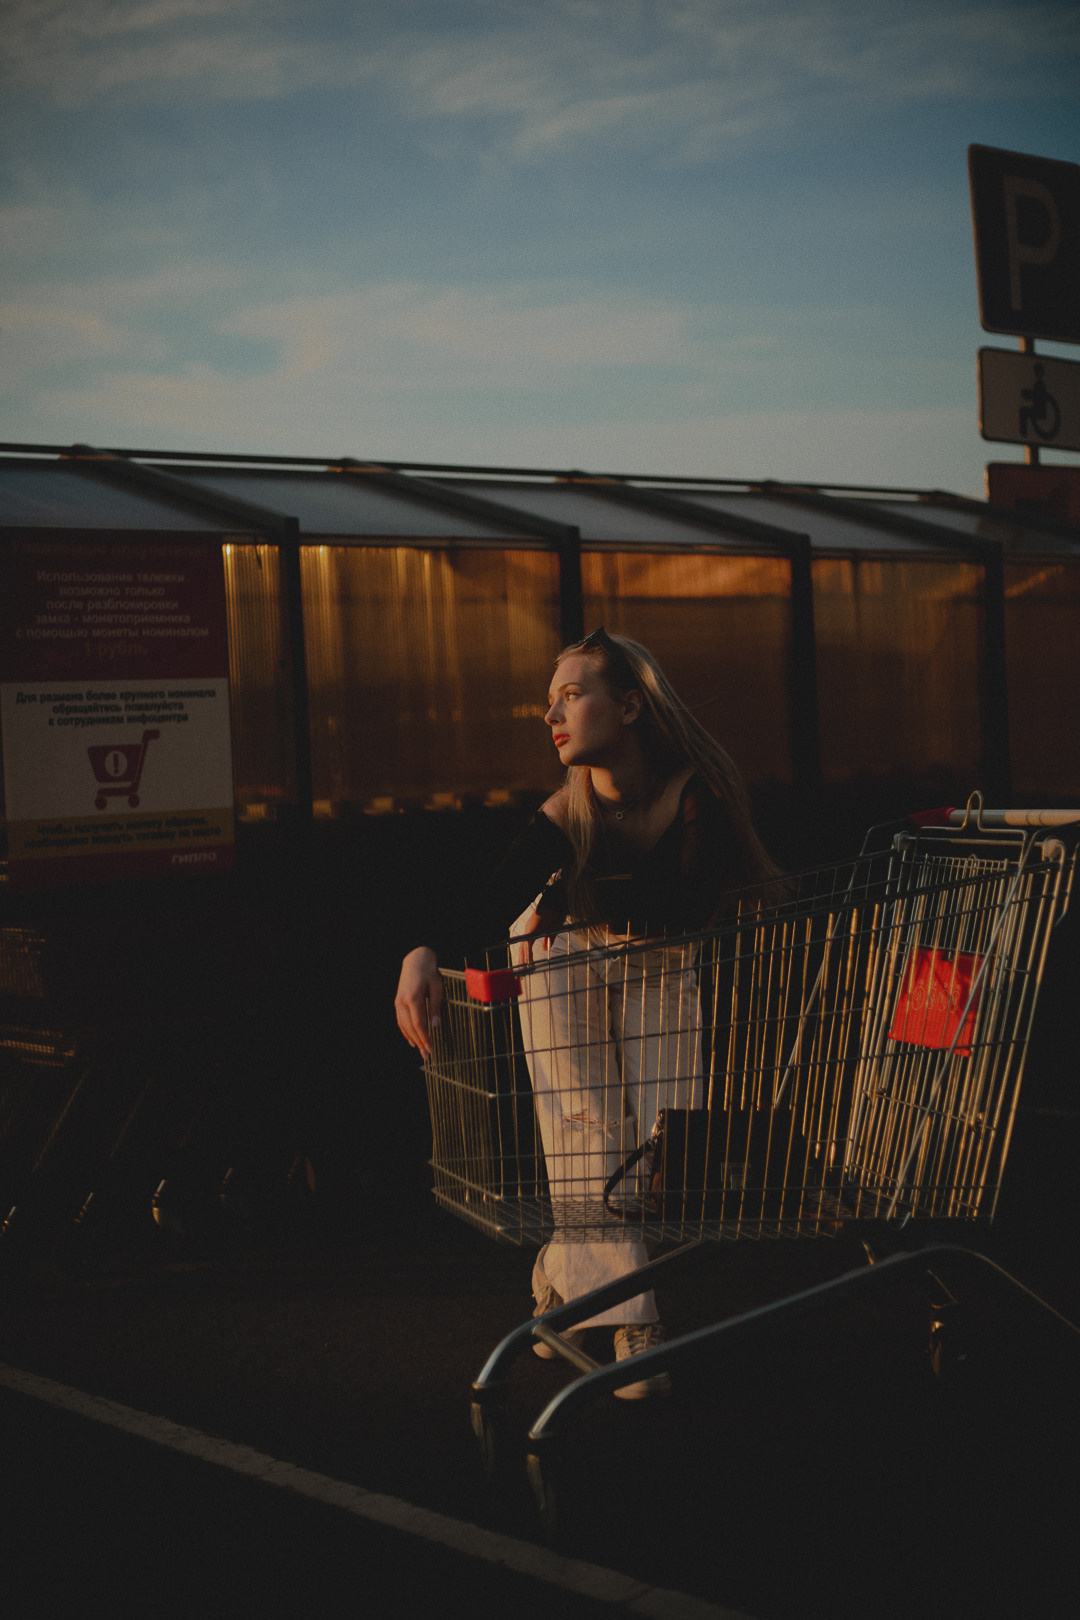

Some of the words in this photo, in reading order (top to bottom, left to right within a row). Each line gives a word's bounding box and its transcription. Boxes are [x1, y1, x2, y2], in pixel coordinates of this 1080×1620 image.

[1003, 175, 1061, 312] P
[36, 570, 133, 583] Использование
[137, 572, 185, 584] тележки
[59, 586, 121, 597] возможно
[124, 586, 166, 597] только
[46, 600, 84, 610] после
[87, 599, 179, 612] разблокировки
[34, 614, 71, 625] замка
[15, 630, 23, 639] с
[26, 628, 88, 639] помощью
[91, 627, 138, 638] монеты
[142, 626, 210, 637] номиналом
[16, 691, 37, 704] Для
[40, 692, 84, 703] размена
[86, 690, 117, 701] более
[120, 690, 166, 702] крупного
[168, 688, 216, 699] номинала
[52, 703, 122, 716] обращайтесь
[124, 700, 184, 713] пожалуйста
[48, 717, 55, 726] к
[57, 715, 125, 728] сотрудникам
[127, 713, 189, 726] инфоцентра
